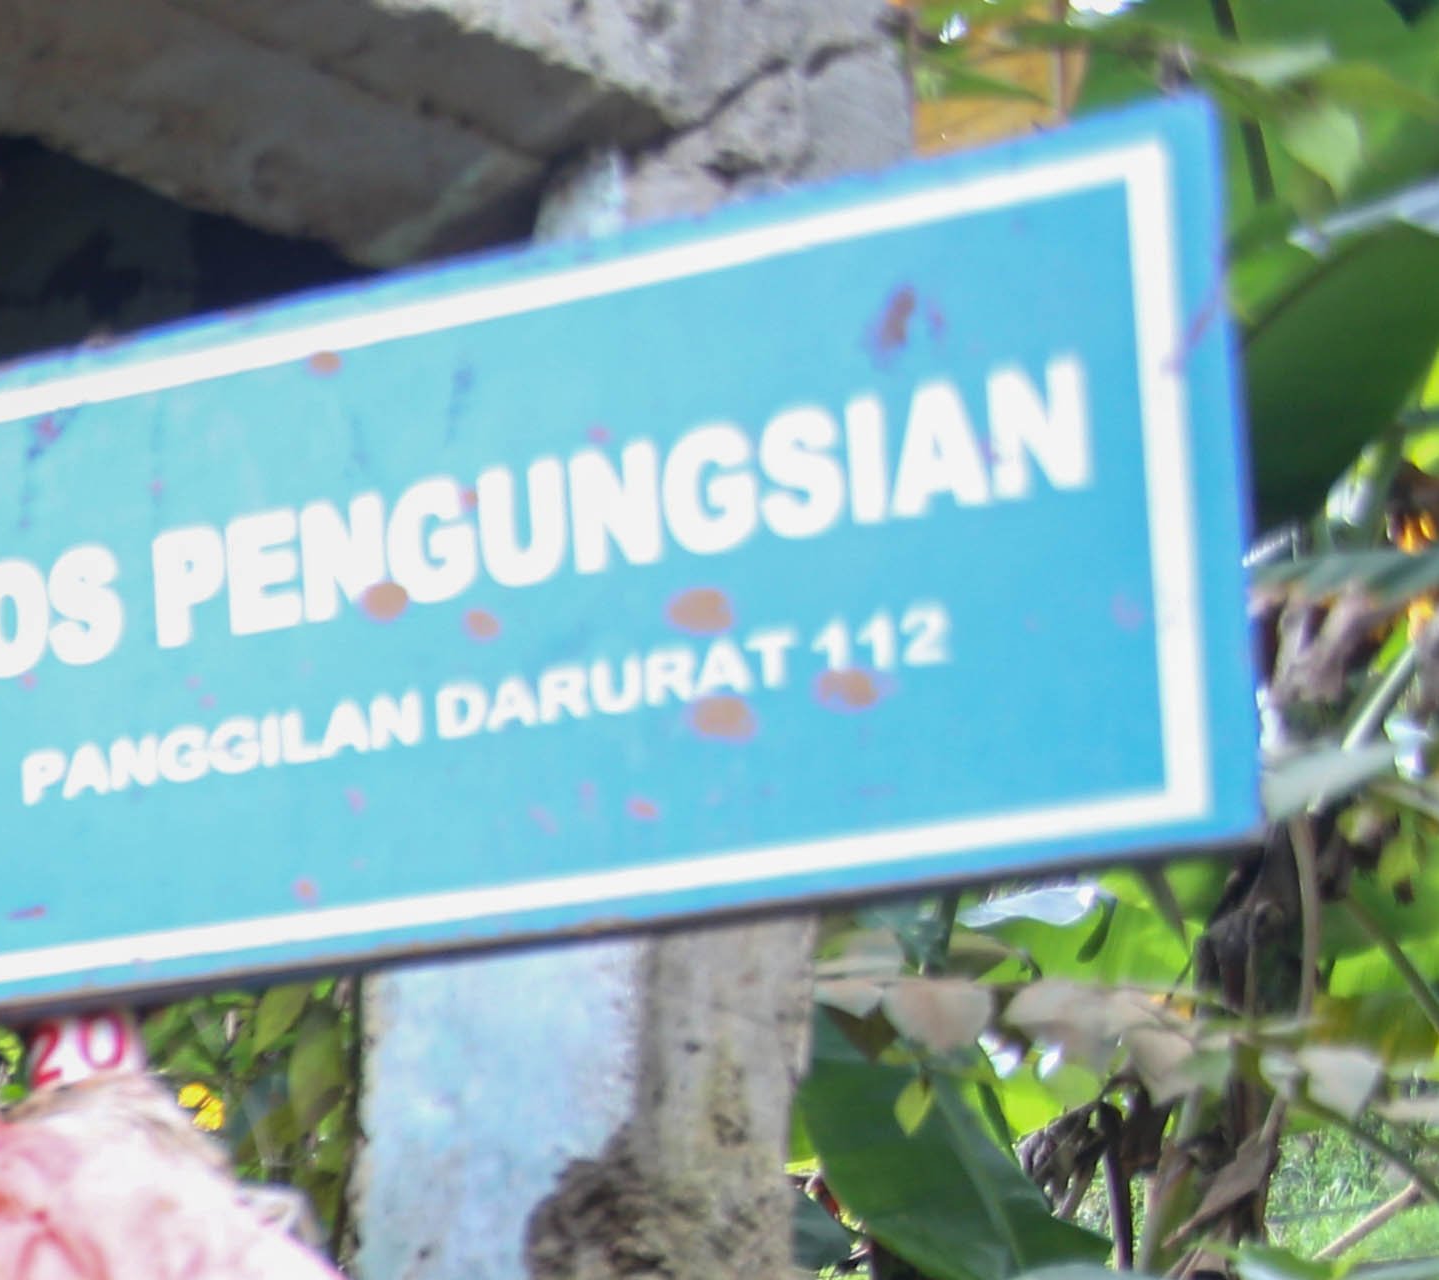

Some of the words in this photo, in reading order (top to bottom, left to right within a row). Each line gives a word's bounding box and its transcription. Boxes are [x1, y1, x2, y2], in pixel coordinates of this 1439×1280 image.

[150, 354, 1091, 651] PENGUNGSIAN
[19, 688, 425, 807] PANGGILAN
[435, 627, 796, 741] DARURAT
[810, 599, 953, 674] 112
[29, 1009, 132, 1090] 20
